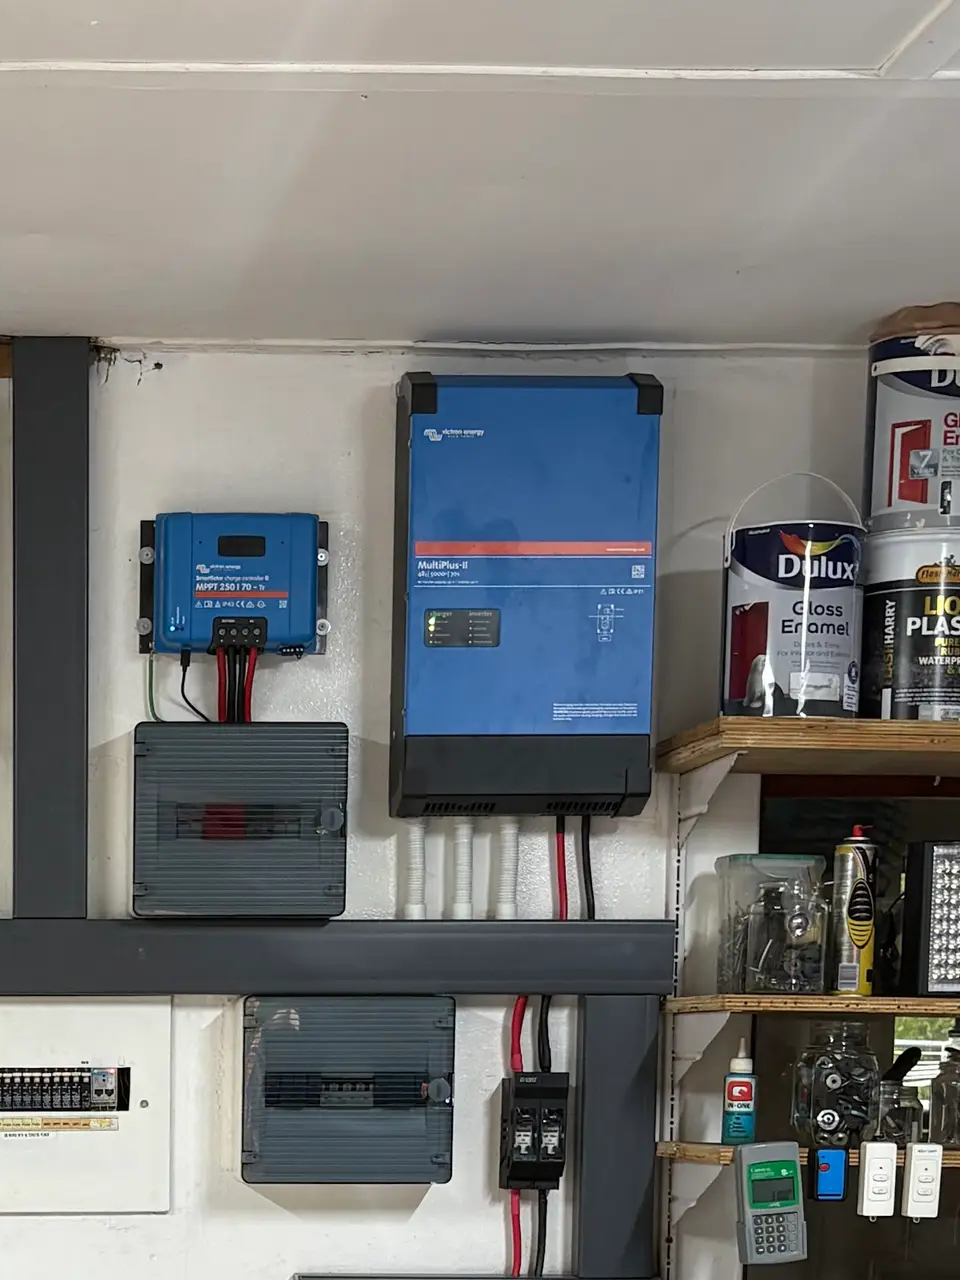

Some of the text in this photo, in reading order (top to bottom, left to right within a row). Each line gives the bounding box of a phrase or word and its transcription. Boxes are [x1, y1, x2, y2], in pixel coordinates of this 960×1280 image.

[463, 429, 485, 437] energy
[417, 560, 468, 570] MultiPlus-II
[778, 554, 854, 580] Dulux
[195, 583, 218, 592] MPPT
[219, 583, 236, 592] 250
[241, 583, 252, 592] 70
[792, 601, 843, 617] Gloss
[781, 619, 850, 637] Enamel
